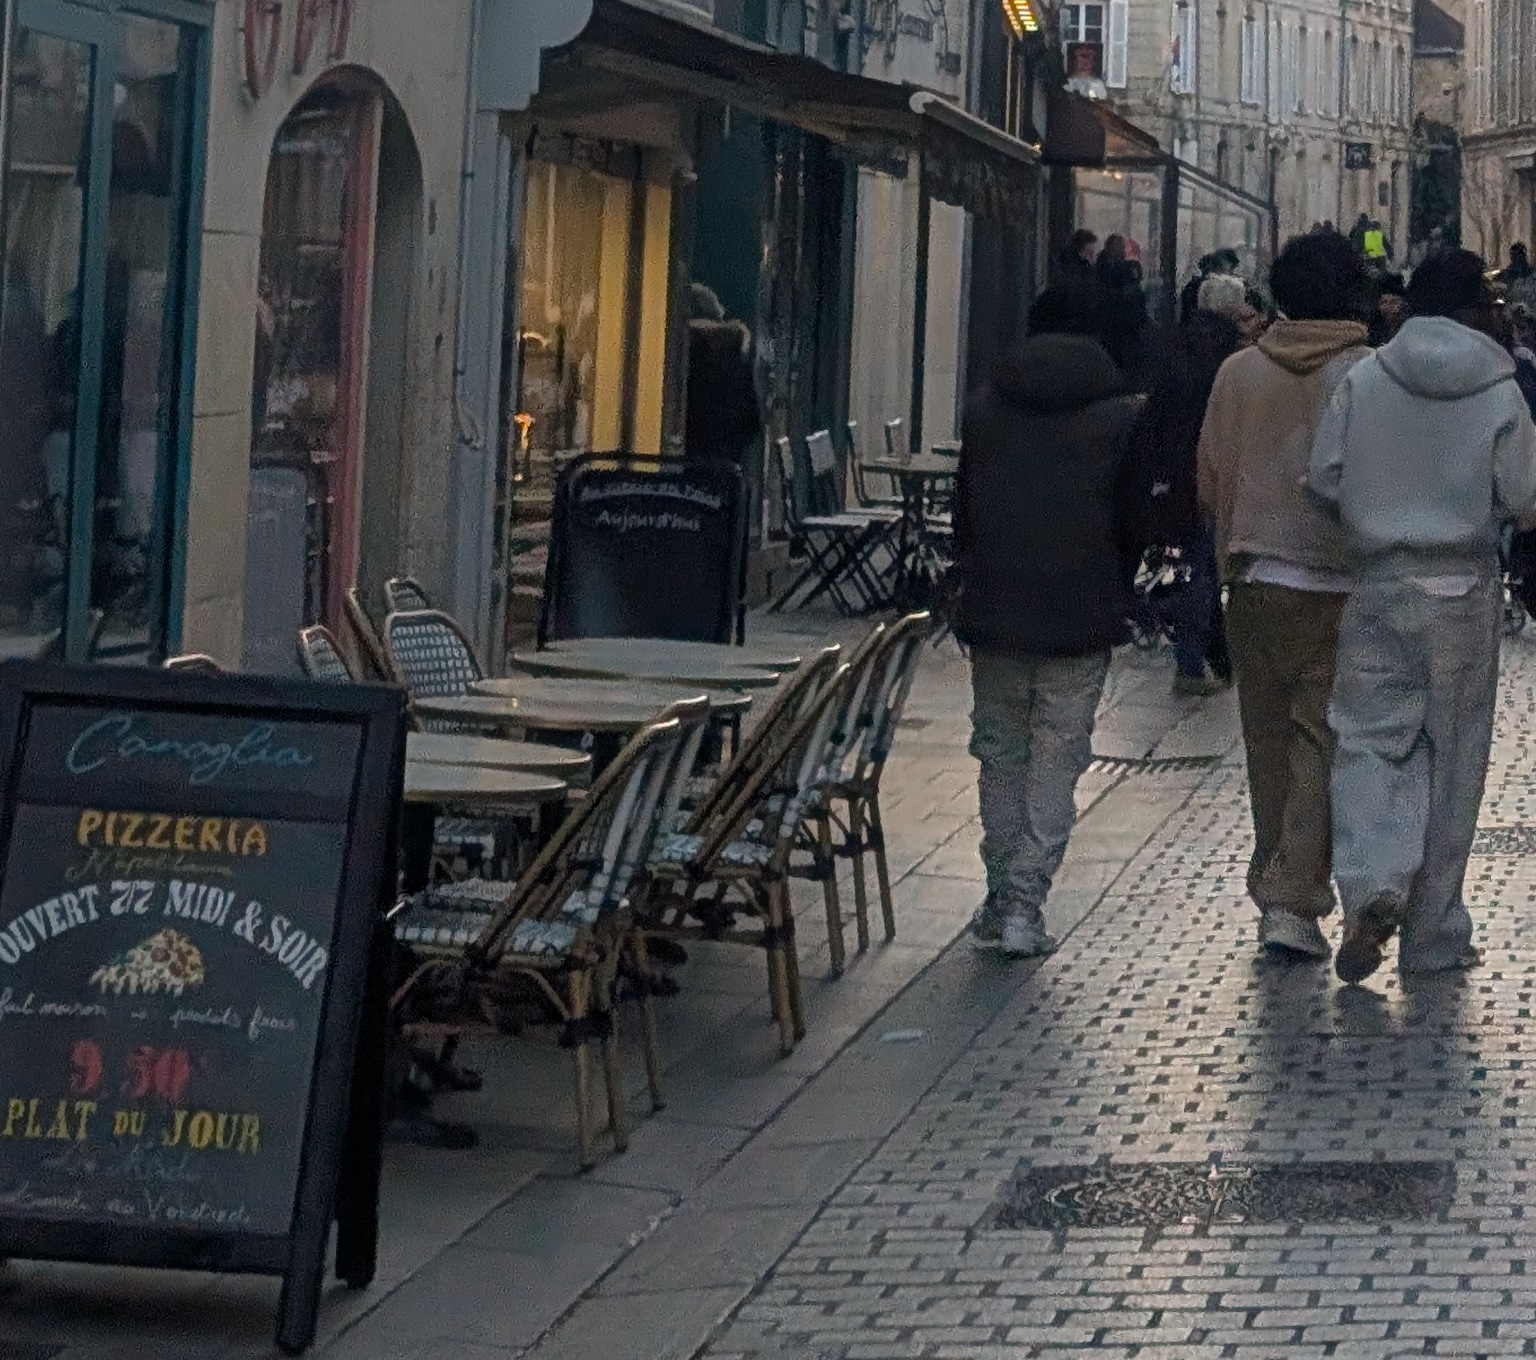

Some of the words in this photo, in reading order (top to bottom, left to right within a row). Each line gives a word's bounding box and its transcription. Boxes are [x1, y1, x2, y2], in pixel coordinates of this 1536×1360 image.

[77, 808, 268, 857] PIZZERIA
[0, 883, 100, 964] OUVERT
[163, 878, 237, 928] MIDI
[258, 914, 328, 990] SOIR
[4, 1097, 98, 1142] PLAT
[112, 1109, 146, 1138] DU
[161, 1109, 261, 1155] JOUR
